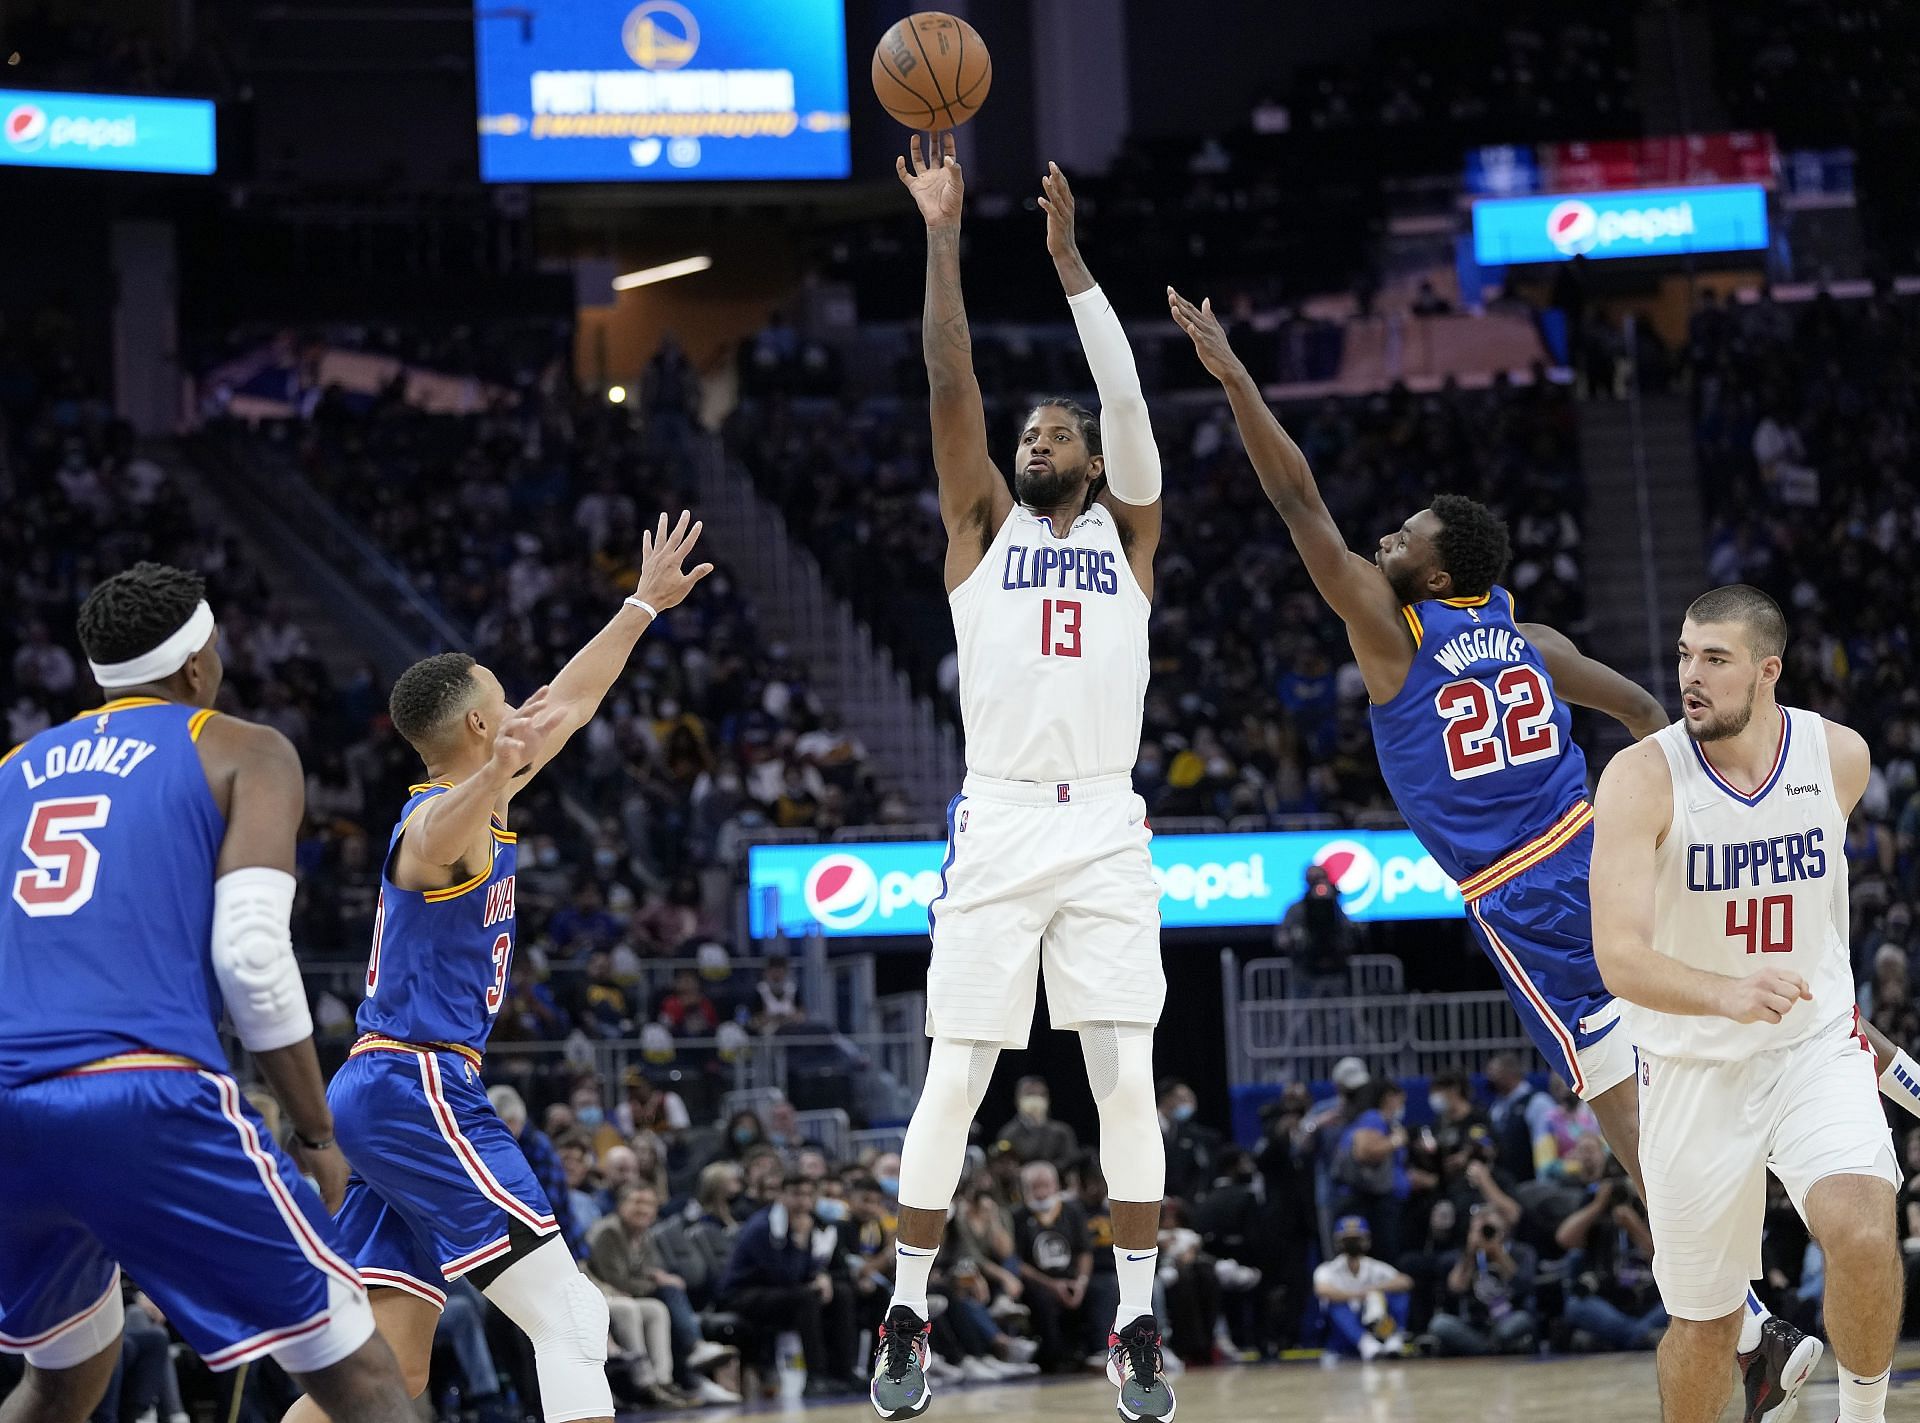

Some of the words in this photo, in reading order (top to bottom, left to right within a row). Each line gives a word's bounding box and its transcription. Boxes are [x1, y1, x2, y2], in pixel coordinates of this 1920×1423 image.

[50, 113, 136, 150] pepsi
[1598, 201, 1694, 245] pepsi
[1002, 545, 1118, 595] CLIPPERS
[1041, 598, 1082, 658] 13
[1433, 627, 1525, 677] WIGGINS
[1434, 663, 1561, 781] 22
[21, 736, 157, 790] LOONEY
[1784, 783, 1822, 798] honey
[12, 794, 112, 918] 5
[1686, 827, 1827, 892] CLIPPERS
[483, 875, 516, 928] WA
[1725, 894, 1794, 955] 40
[485, 932, 515, 1015] 3
